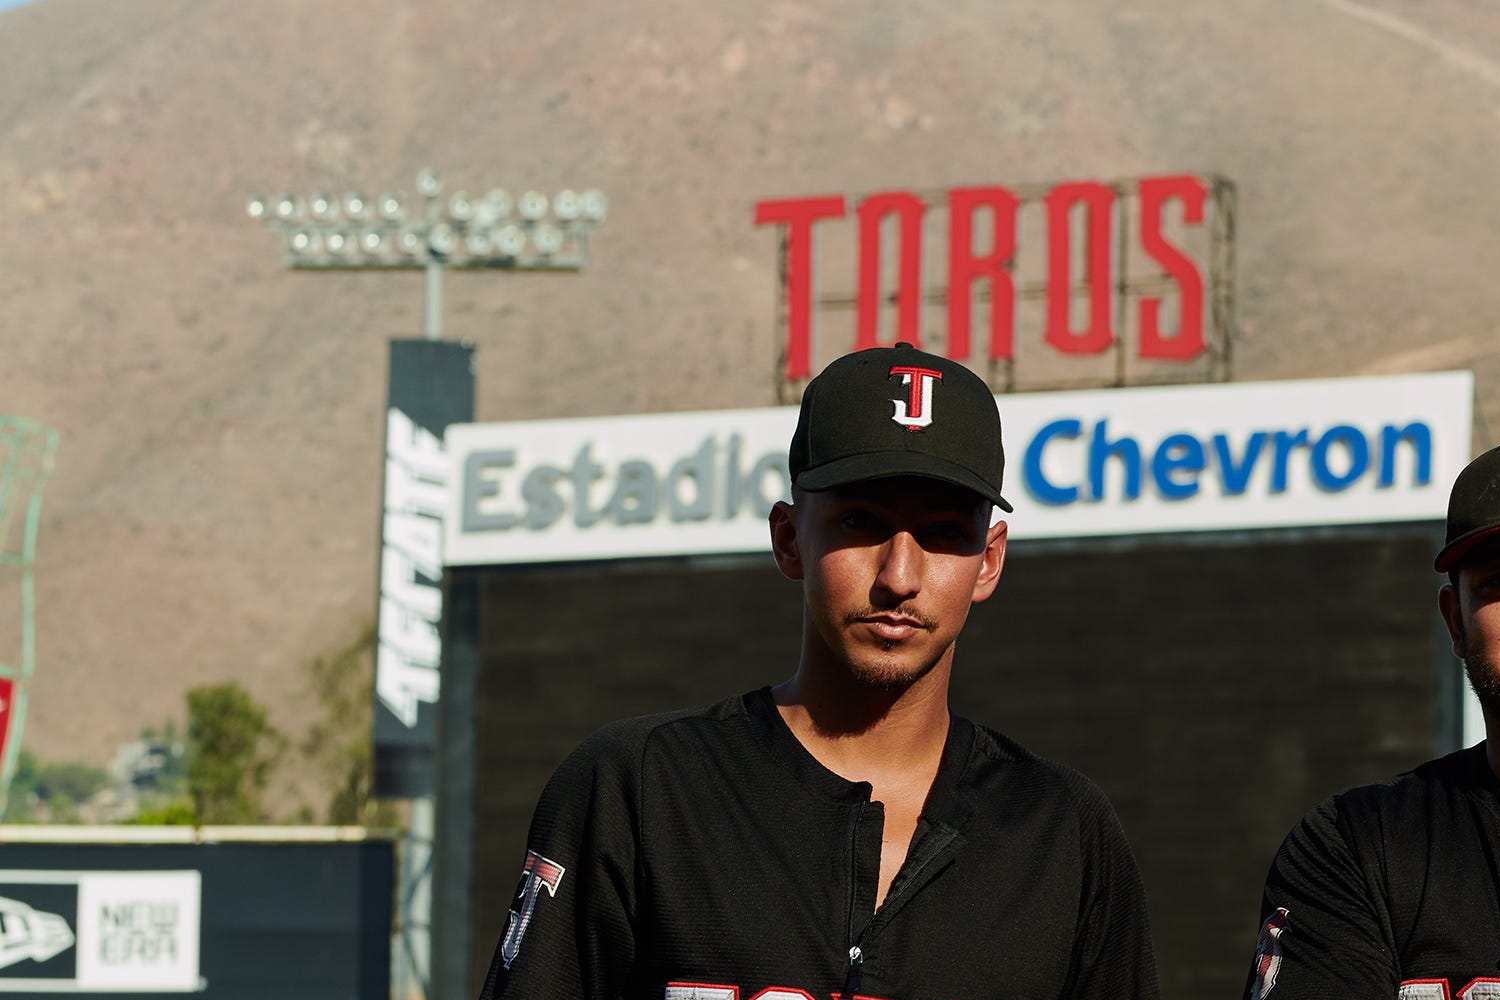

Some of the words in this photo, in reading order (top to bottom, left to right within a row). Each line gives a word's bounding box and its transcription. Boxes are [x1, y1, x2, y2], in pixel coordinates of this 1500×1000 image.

[754, 174, 1208, 381] TOROS
[462, 430, 791, 533] Estadio
[1023, 417, 1432, 506] Chevron
[98, 899, 181, 931] NEW
[98, 933, 181, 966] ERA
